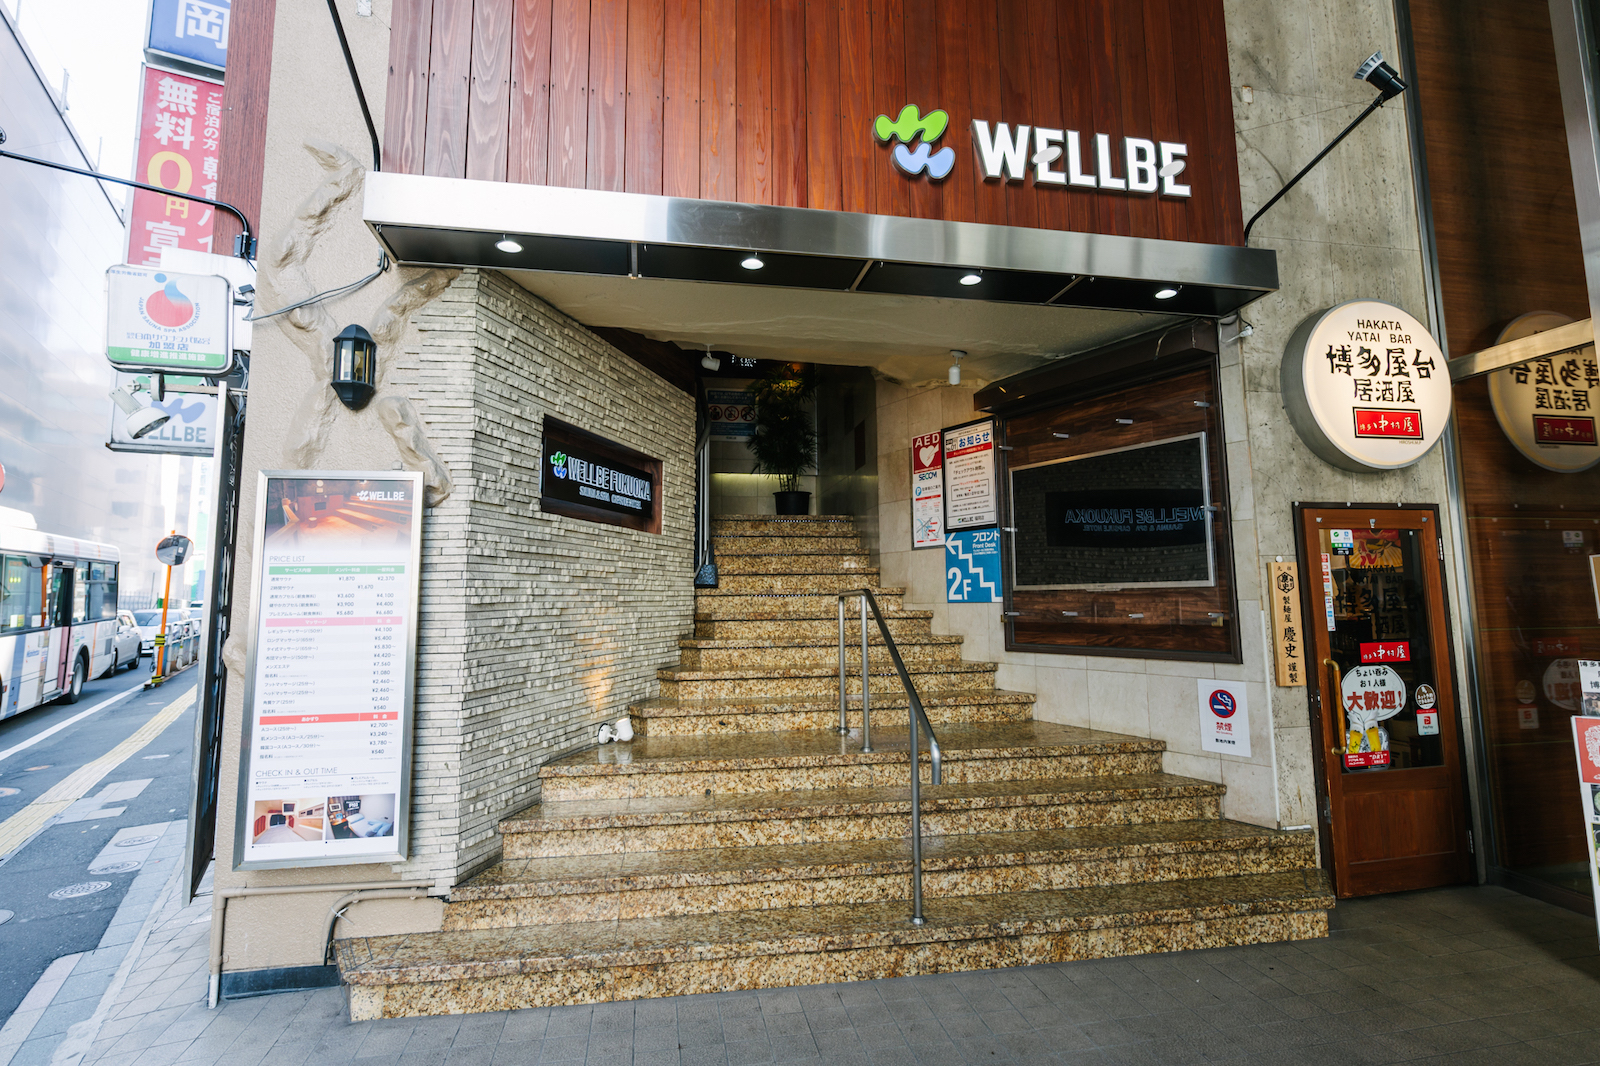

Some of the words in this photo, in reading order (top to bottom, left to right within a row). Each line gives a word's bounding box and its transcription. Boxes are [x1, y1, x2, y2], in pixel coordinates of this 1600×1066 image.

[971, 118, 1192, 198] WELLBE
[142, 316, 161, 331] SAUNA
[178, 302, 201, 332] ASSOCIATION
[1356, 319, 1402, 331] HAKATA
[1348, 331, 1380, 342] YATAI
[1390, 334, 1412, 344] BAR
[148, 341, 189, 351] 加盟店
[130, 349, 206, 362] 健康増進推進施設
[1326, 344, 1436, 379] 博多屋台
[1353, 378, 1416, 403] 居酒屋
[914, 434, 940, 448] AED
[958, 432, 990, 448] お知らせ
[568, 456, 610, 489] WELLBE
[610, 470, 652, 502] FUKUOKA
[918, 471, 938, 481] SECOM
[370, 491, 405, 500] WELLBE
[972, 530, 1000, 542] フロント
[948, 567, 972, 600] 2F
[1283, 626, 1299, 659] 慶史
[1356, 668, 1388, 677] ちょい呑み
[1360, 679, 1386, 688] お1人様
[1347, 690, 1402, 712] 大歓迎!
[1216, 722, 1232, 732] 禁煙
[256, 769, 283, 777] CHECK
